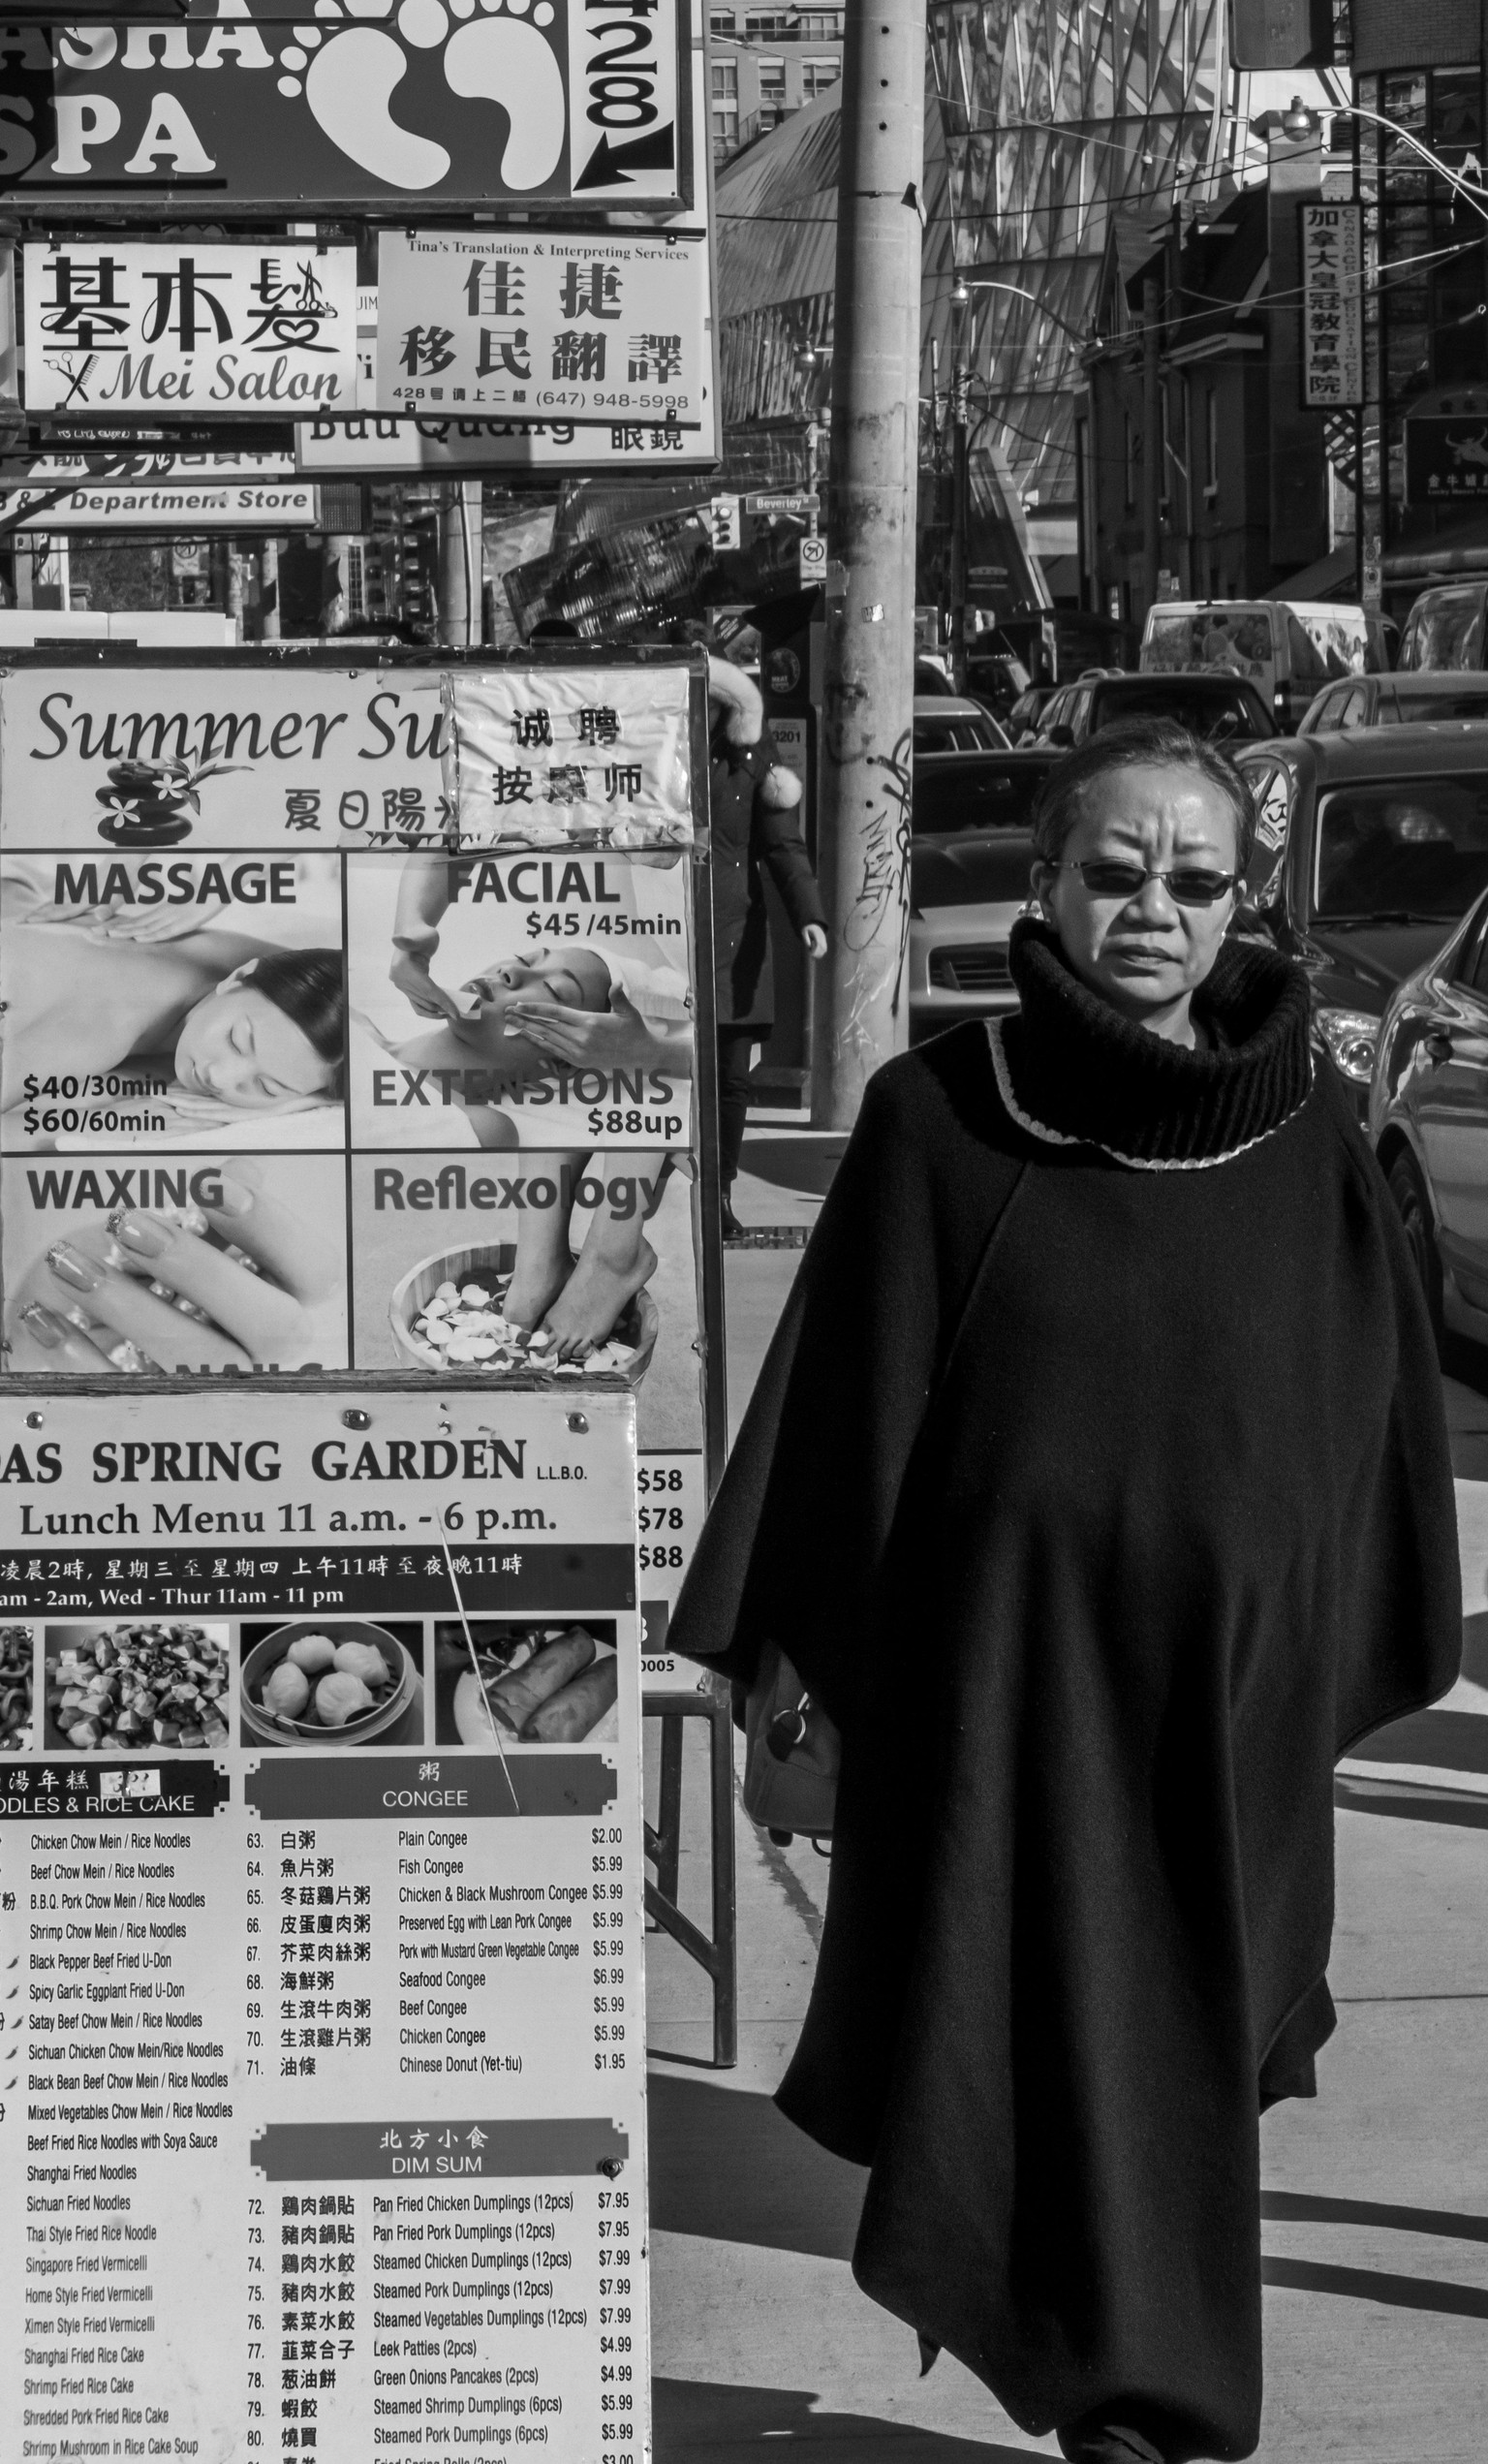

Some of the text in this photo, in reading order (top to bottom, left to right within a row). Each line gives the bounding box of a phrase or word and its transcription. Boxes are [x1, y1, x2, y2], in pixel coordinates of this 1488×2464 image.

[408, 239, 690, 261] Tina's Translation & Interpreting Services
[463, 259, 623, 320] 佳捷
[399, 326, 682, 384] 移民翻譯
[99, 354, 194, 400] Mei
[209, 355, 341, 400] Salon
[537, 391, 585, 408] (647)
[594, 393, 688, 411] 948-5998
[70, 490, 230, 514] Department
[237, 490, 307, 509] Store
[757, 497, 802, 511] Beverley
[30, 692, 348, 760] Summer
[511, 705, 620, 748] 诚聘
[54, 861, 296, 905] MASSAGE
[448, 861, 620, 904] FACIAL
[373, 1068, 674, 1107] EXTENSIONS
[589, 1108, 683, 1139] $88up
[27, 1168, 226, 1211] WAXING
[374, 1164, 668, 1223] Reflexology
[0, 1439, 587, 1483] AS SPRING GARDEN L.L.B.O.
[637, 1468, 683, 1494] $58
[20, 1503, 140, 1535] Lunch
[153, 1504, 265, 1533] Menu
[278, 1504, 316, 1532] 11
[329, 1511, 406, 1532] a.m.
[445, 1502, 463, 1530] 6
[476, 1509, 556, 1540] p.m.
[638, 1506, 683, 1532] $78
[639, 1544, 683, 1571] $88
[46, 1591, 92, 1607] 2am,
[100, 1589, 141, 1605] Wed
[162, 1588, 211, 1604] Thur
[217, 1589, 265, 1603] 11am
[287, 1588, 303, 1602] 11
[313, 1591, 343, 1607] pm
[419, 1762, 439, 1781] 粥
[66, 1797, 78, 1812] &
[85, 1796, 132, 1812] RICE
[140, 1795, 195, 1812] CAKE
[383, 1791, 468, 1806] CONGEE
[246, 1826, 623, 1850] 63. 白粥 Plain Congee $2.00
[246, 1855, 623, 1878] 64. 魚片粥 Fish Congee $5.99
[246, 1888, 264, 1905] 65.
[398, 1887, 442, 1903] Chicken
[445, 1886, 453, 1903] &
[456, 1886, 486, 1902] Black
[489, 1885, 545, 1902] Mushroom
[547, 1884, 588, 1904] Congee
[592, 1883, 623, 1901] $5.99
[29, 1981, 185, 2003] Spicy Garlic Eggplant Fried U-Don
[246, 2002, 264, 2019] 69.
[399, 1999, 424, 2016] Beef
[426, 1999, 468, 2019] Congee
[593, 1995, 625, 2014] $5.99
[246, 2059, 264, 2075] 71.
[399, 2056, 443, 2074] Chinese
[446, 2055, 479, 2073] Donut
[594, 2052, 626, 2072] $1.95
[380, 2126, 488, 2149] 北方小食
[26, 2164, 138, 2185] Shanghai Fried Noodles
[392, 2157, 481, 2173] DIM SUM
[247, 2199, 265, 2215] 72.
[373, 2196, 393, 2213] Pan
[396, 2196, 424, 2212] Fried
[426, 2195, 471, 2212] Chicken
[473, 2194, 531, 2214] Dumplings
[534, 2191, 574, 2213] (12pcs)
[598, 2191, 630, 2210] $7.95
[25, 2255, 148, 2277] Singapore Fried Vermicelli
[247, 2342, 264, 2359] 77.
[373, 2340, 400, 2357] Leek
[403, 2340, 441, 2357] Patties
[442, 2339, 478, 2359] (2pcs)
[600, 2335, 632, 2355] $4.99
[247, 2371, 264, 2388] 78.
[373, 2369, 406, 2386] Green
[409, 2368, 448, 2386] Onions
[450, 2367, 503, 2385] Pancakes
[505, 2366, 539, 2387] (2pcs)
[601, 2364, 633, 2384] $4.99
